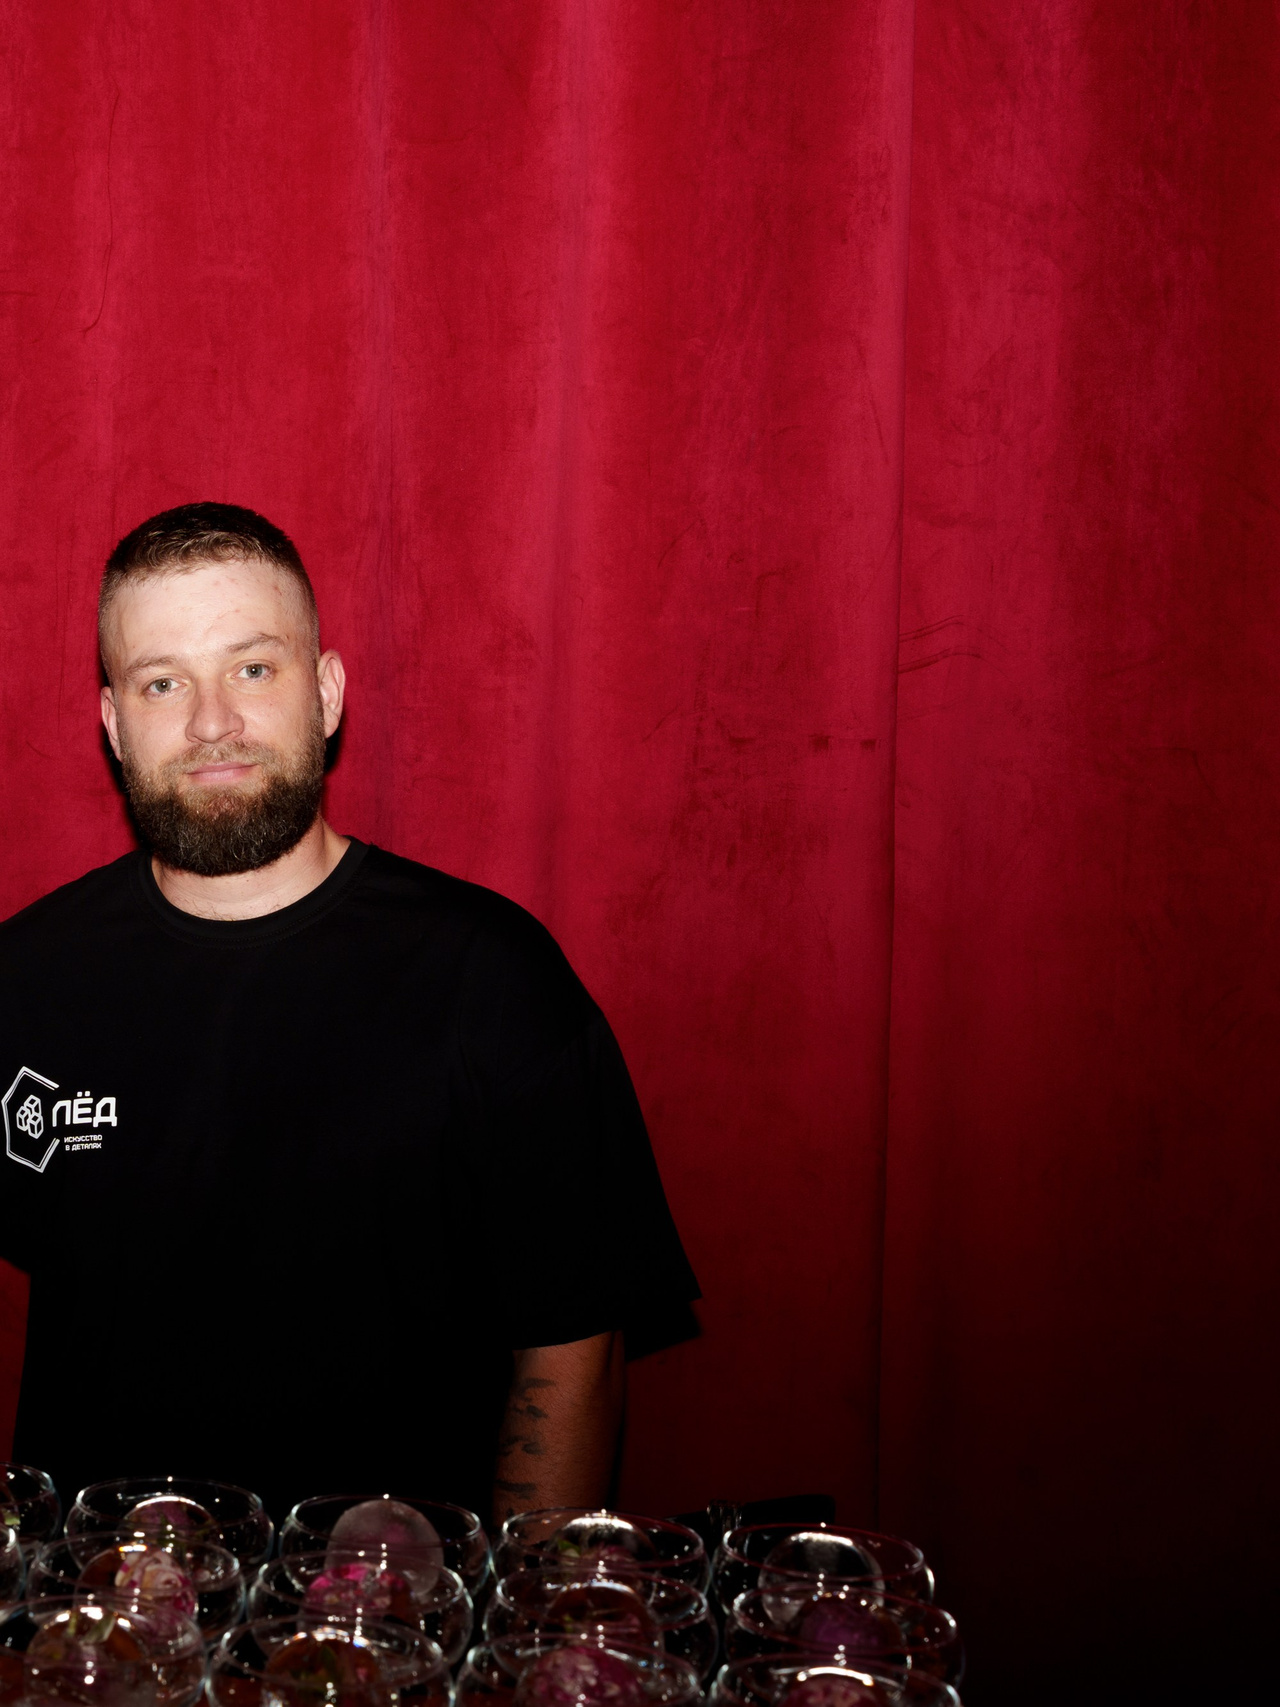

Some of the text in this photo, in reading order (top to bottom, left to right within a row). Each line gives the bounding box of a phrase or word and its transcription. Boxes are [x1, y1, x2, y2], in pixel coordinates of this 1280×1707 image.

[52, 1091, 117, 1127] ЛЁД
[64, 1134, 103, 1143] ИСКУССТВО
[71, 1142, 102, 1151] ДЕТАЛЯХ
